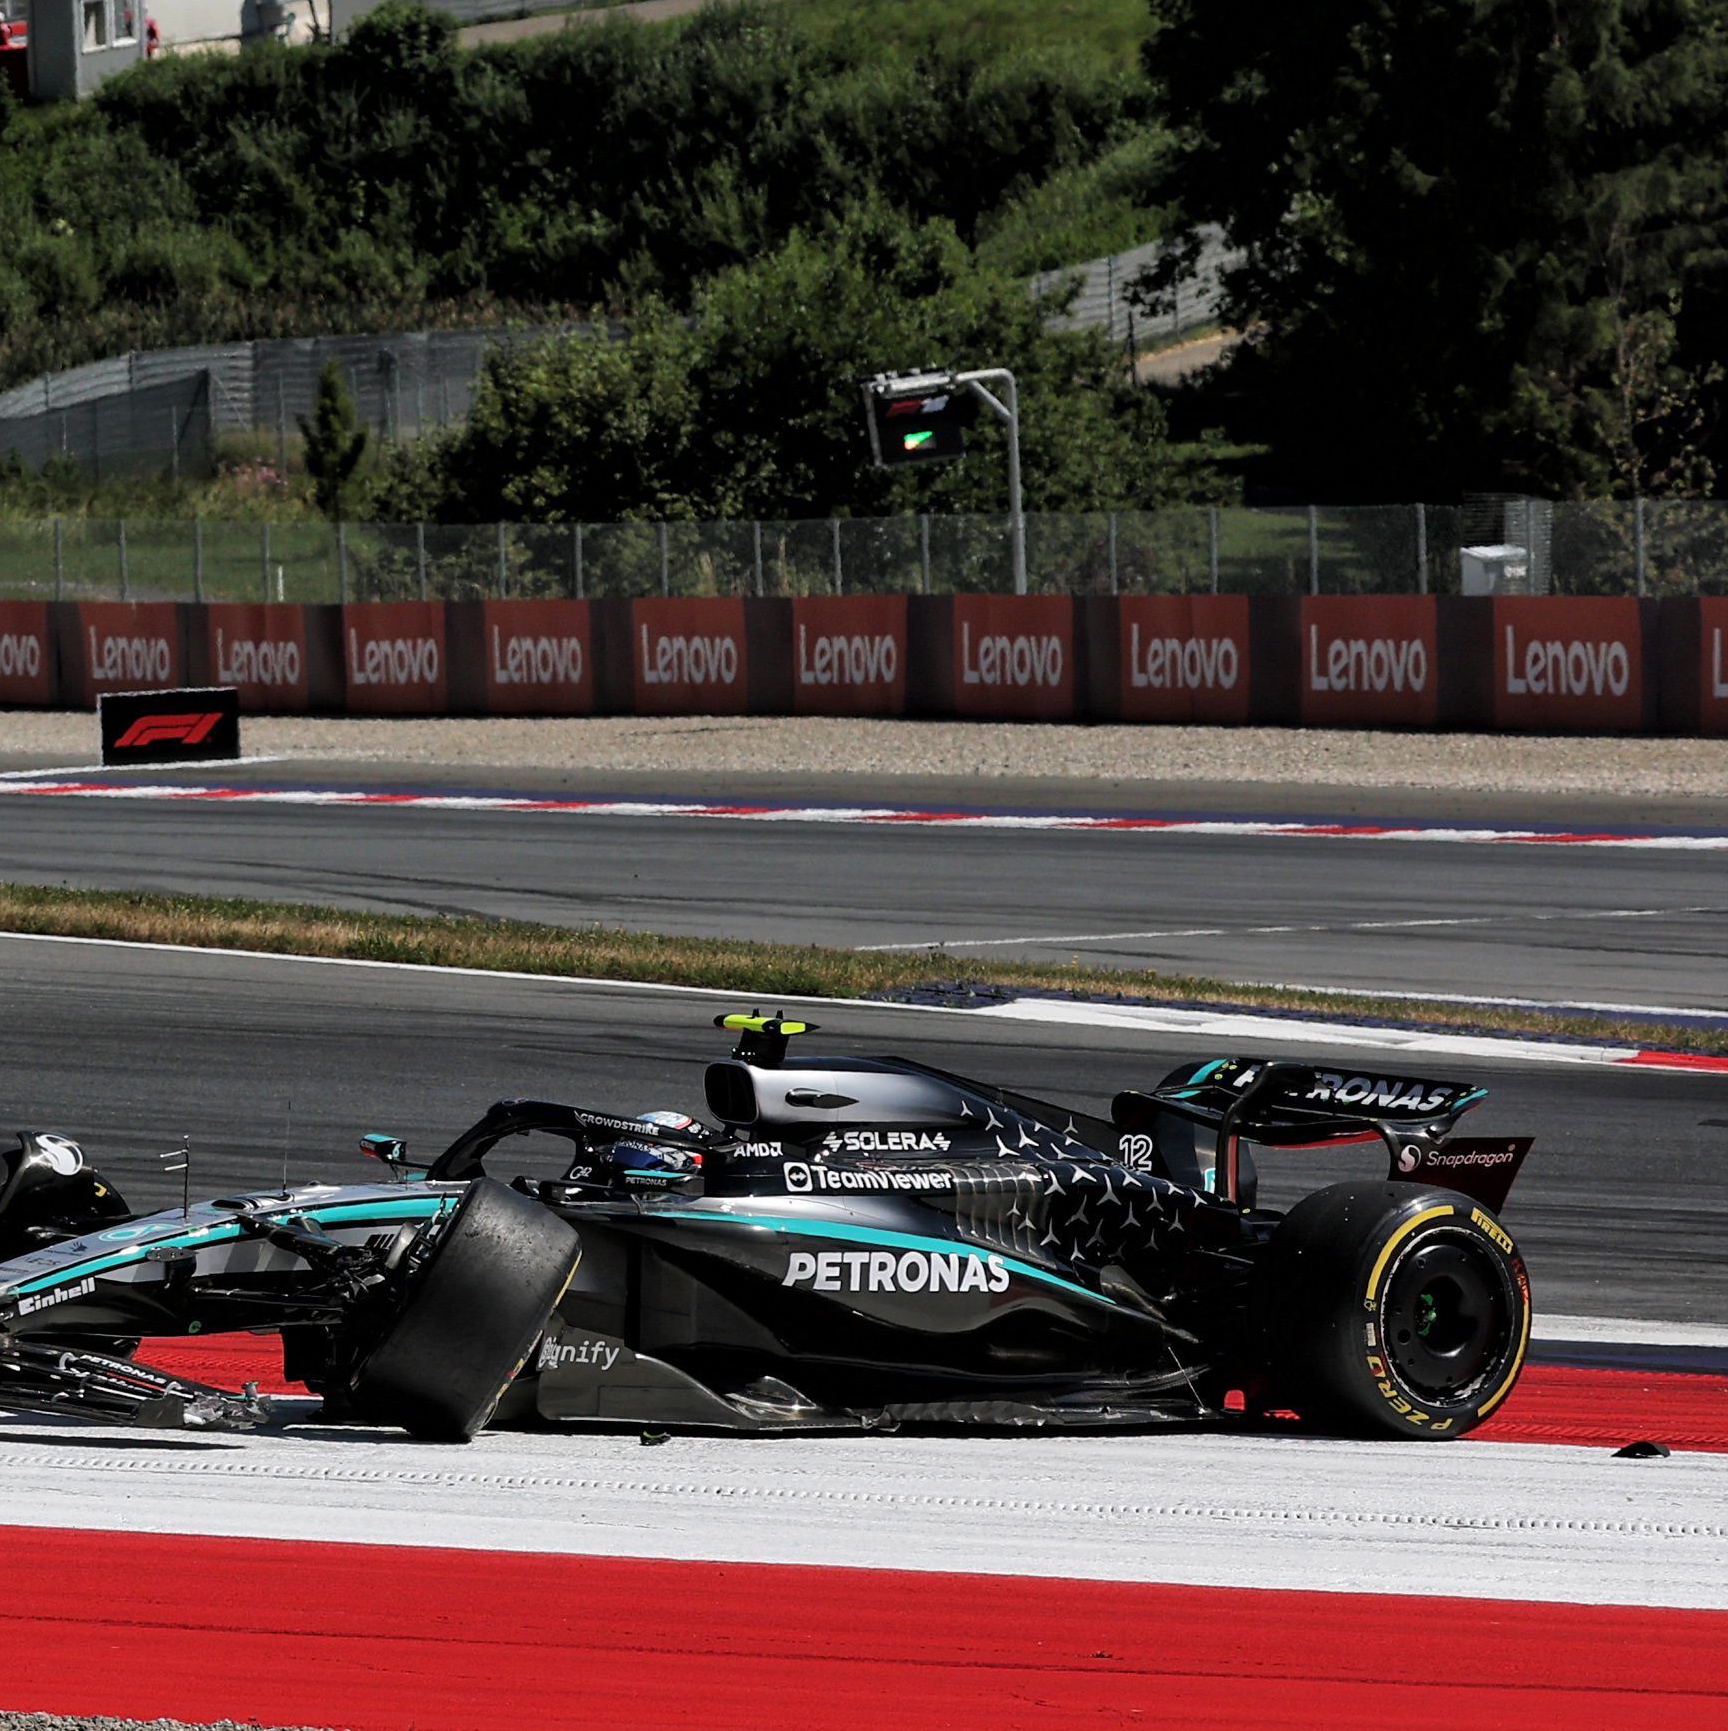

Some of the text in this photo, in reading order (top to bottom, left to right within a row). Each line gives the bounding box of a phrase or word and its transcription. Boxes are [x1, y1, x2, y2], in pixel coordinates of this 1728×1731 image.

[89, 626, 171, 681] Lenovo
[216, 627, 302, 685] Lenovo
[350, 627, 439, 684] Lenovo
[493, 625, 582, 684] Lenovo
[642, 624, 737, 683] Lenovo
[799, 624, 897, 683] Lenovo
[963, 622, 1063, 685] Lenovo
[1131, 624, 1238, 689] Lenovo
[1311, 625, 1427, 692] Lenovo
[1505, 625, 1630, 696] Lenovo
[1233, 1065, 1454, 1112] PRONAS
[579, 1113, 660, 1137] CROWDSTRIKE
[843, 1131, 937, 1152] SOLERA
[734, 1142, 783, 1158] AMD
[1119, 1134, 1154, 1171] 12
[1425, 1146, 1515, 1169] Snapdragon
[625, 1176, 668, 1187] PETRONAS
[810, 1167, 952, 1191] TeamViewer
[1470, 1207, 1514, 1255] PIRELLI
[783, 1252, 1010, 1292] PETRONAS
[17, 1276, 97, 1317] Einhell
[79, 1354, 167, 1385] PETRONAS
[1366, 1355, 1430, 1426] ZERO
